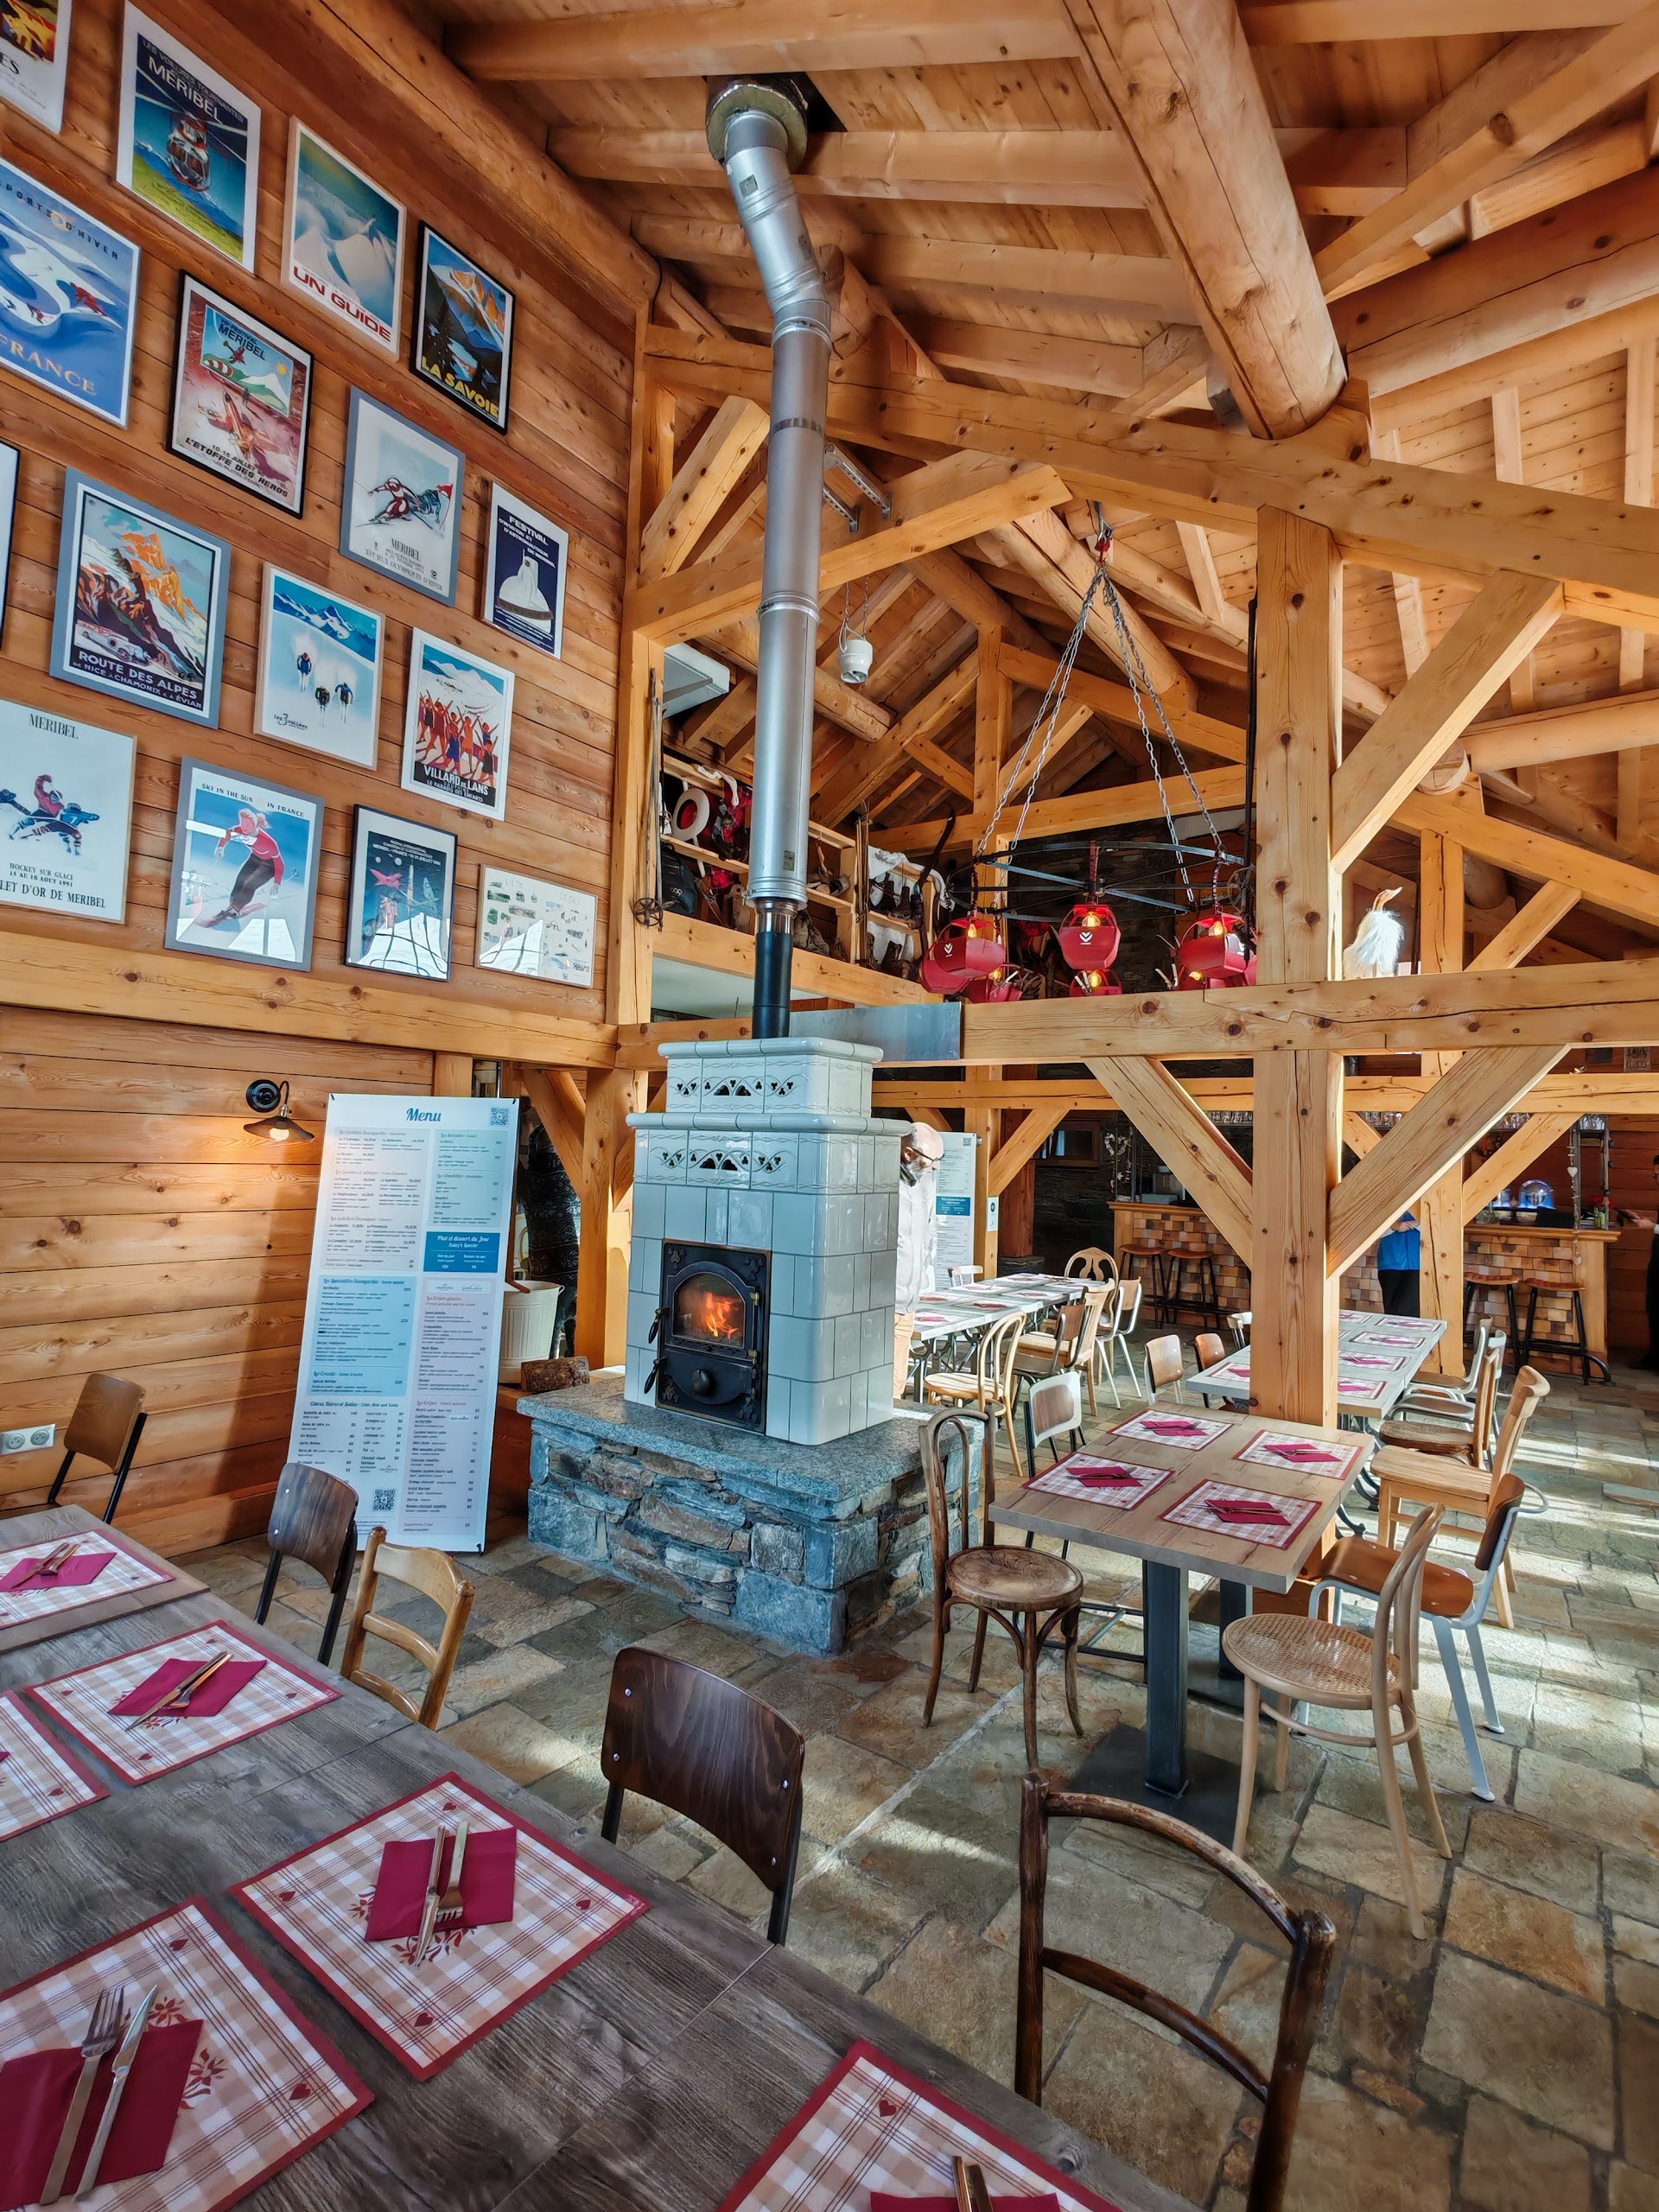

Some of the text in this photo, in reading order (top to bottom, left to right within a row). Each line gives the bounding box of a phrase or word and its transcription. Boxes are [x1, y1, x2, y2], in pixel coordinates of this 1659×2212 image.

[0, 182, 118, 260] PORTS D'HIVER
[294, 265, 325, 296] UN
[331, 292, 391, 343] GUIDE
[219, 323, 266, 361] MERIBEL
[421, 355, 442, 380] LA
[444, 373, 499, 420] SAVOIE
[185, 437, 289, 498] L'ETOFFE DES HEROS
[509, 515, 550, 547] FESTIVAL
[79, 651, 197, 700] ROUTE DES ALPES
[85, 664, 106, 677] NICE
[113, 674, 162, 696] CHAMONIX
[29, 713, 79, 740] MERIBEL
[277, 713, 289, 726] 3
[423, 765, 461, 786] VILLARD
[467, 779, 489, 796] LANS
[201, 783, 213, 791] SKI
[226, 790, 239, 799] THE
[240, 794, 254, 804] SUN
[277, 804, 305, 817] FRANCE
[10, 863, 37, 874] HOCKEY
[54, 871, 74, 880] GLACE
[40, 876, 58, 885] AOUT
[22, 883, 47, 898] D'OR
[50, 888, 63, 900] DE
[67, 892, 106, 908] MERIBEL
[406, 1108, 442, 1122] Menu
